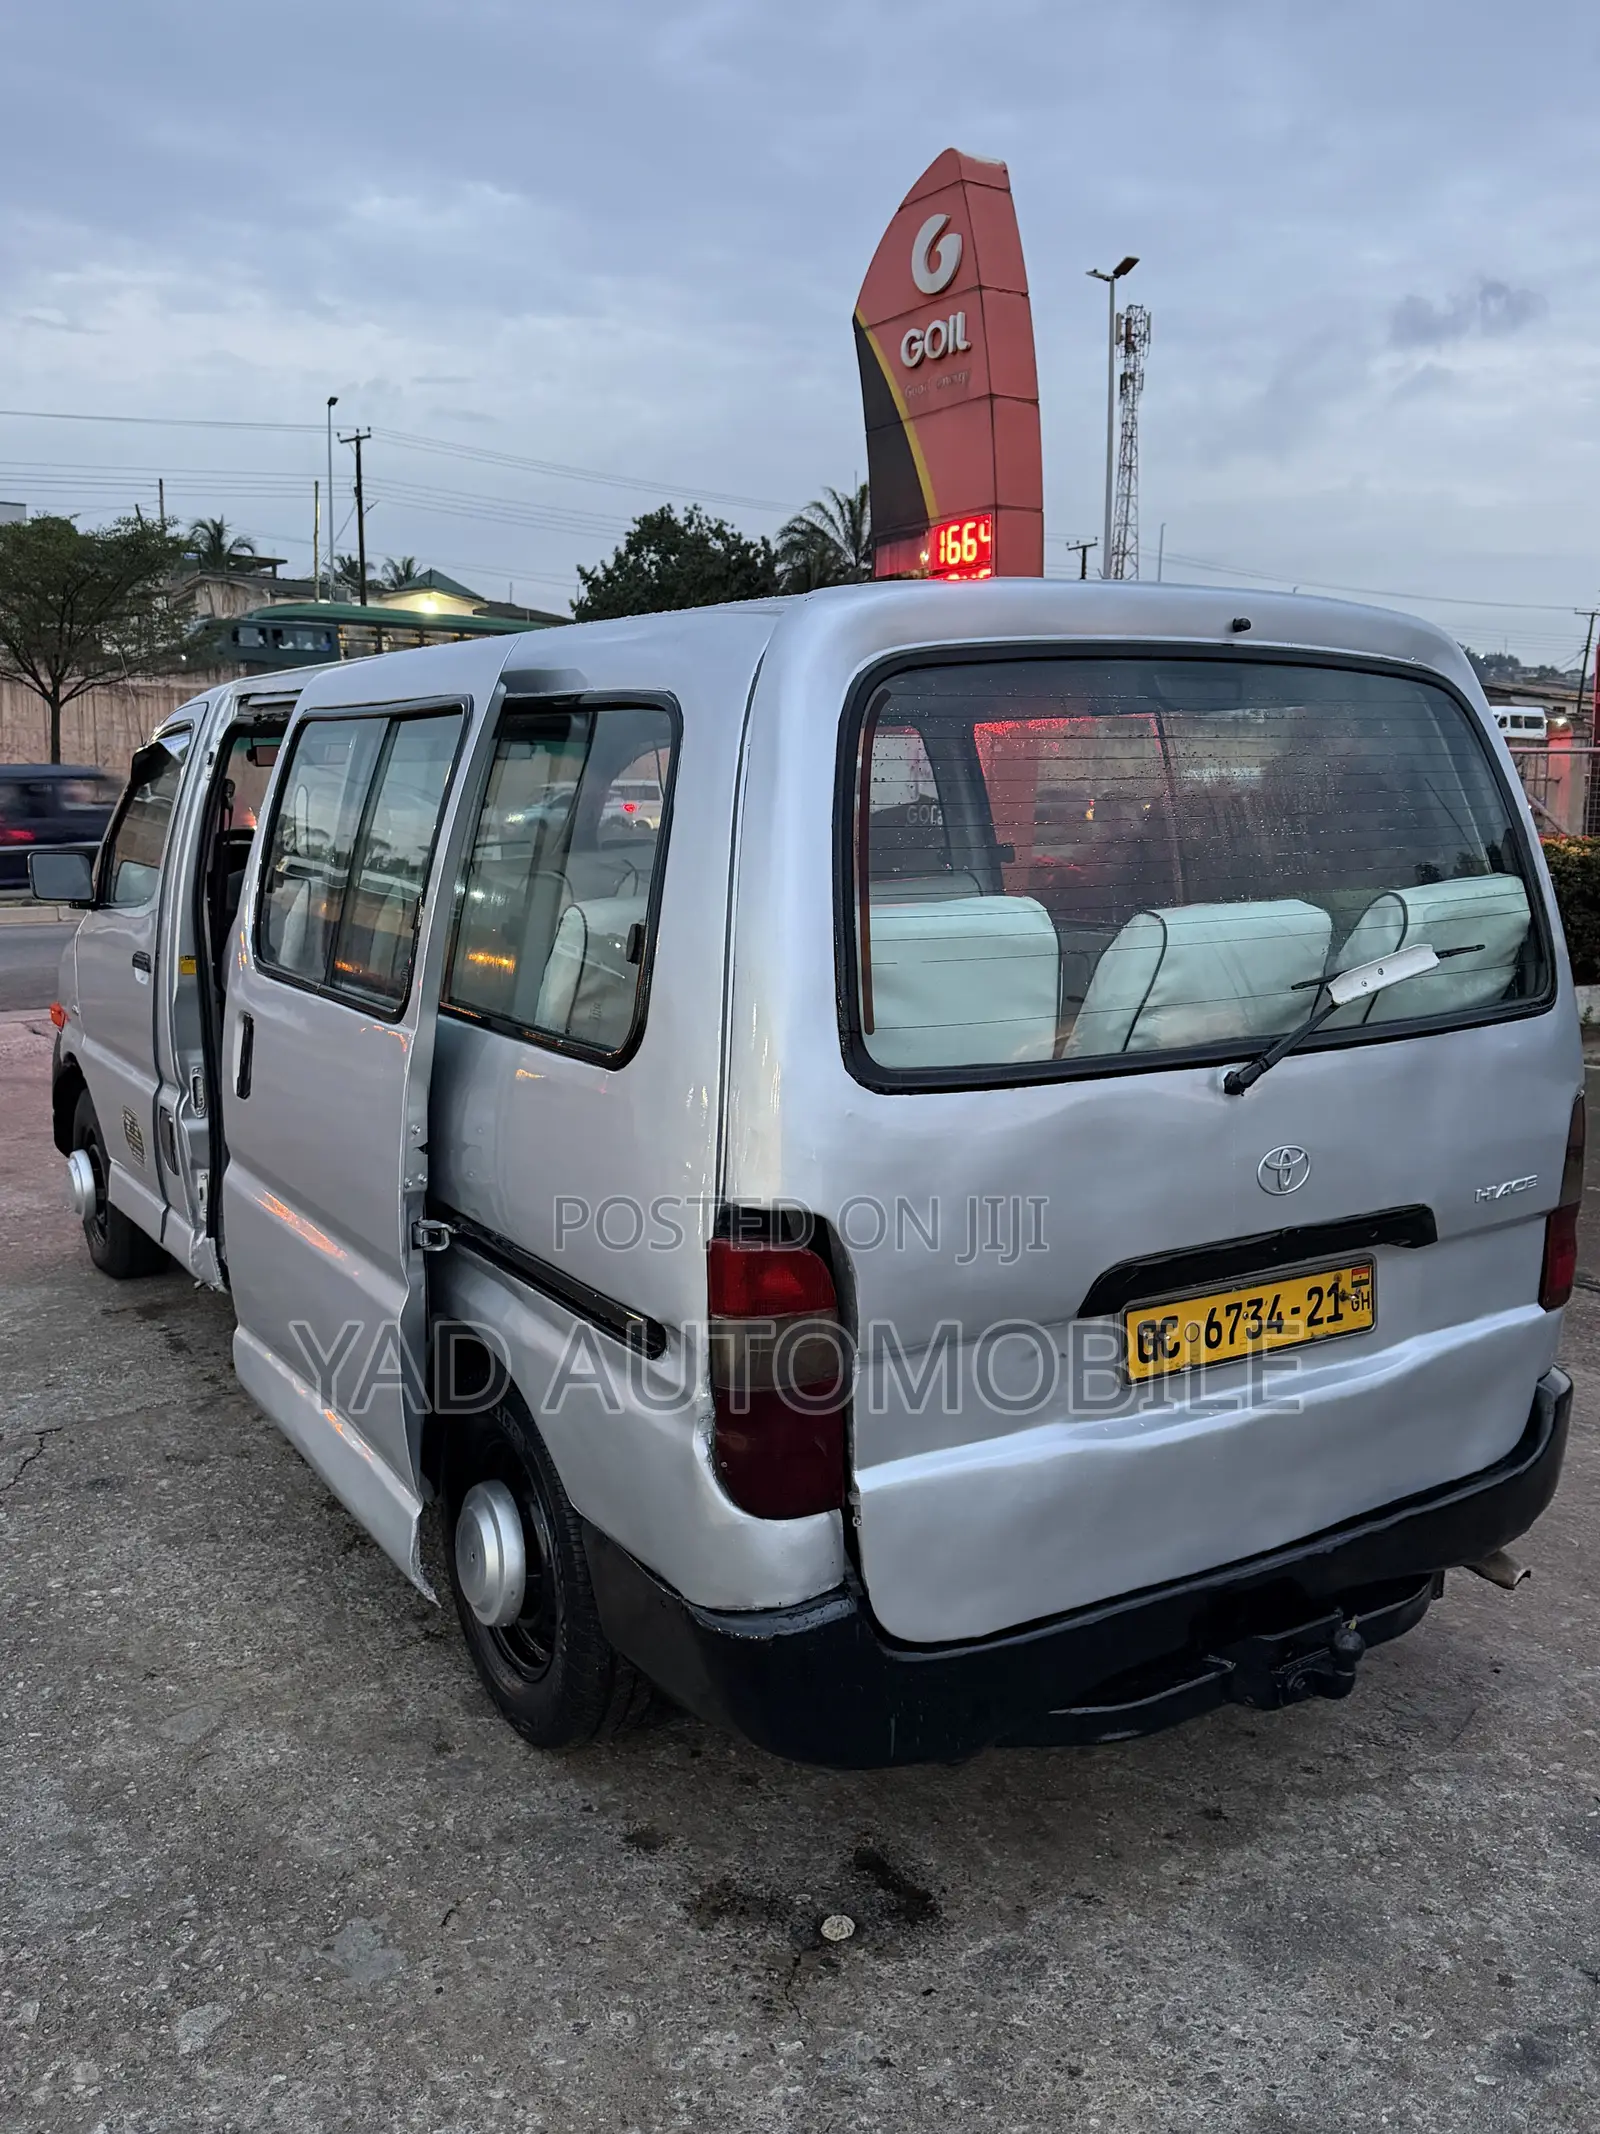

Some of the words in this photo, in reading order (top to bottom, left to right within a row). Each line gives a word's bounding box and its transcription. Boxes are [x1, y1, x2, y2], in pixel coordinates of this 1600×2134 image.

[901, 312, 971, 368] GOIL
[1137, 1315, 1181, 1364] GC
[1204, 1281, 1344, 1350] 6734-21
[1350, 1290, 1371, 1312] GH
